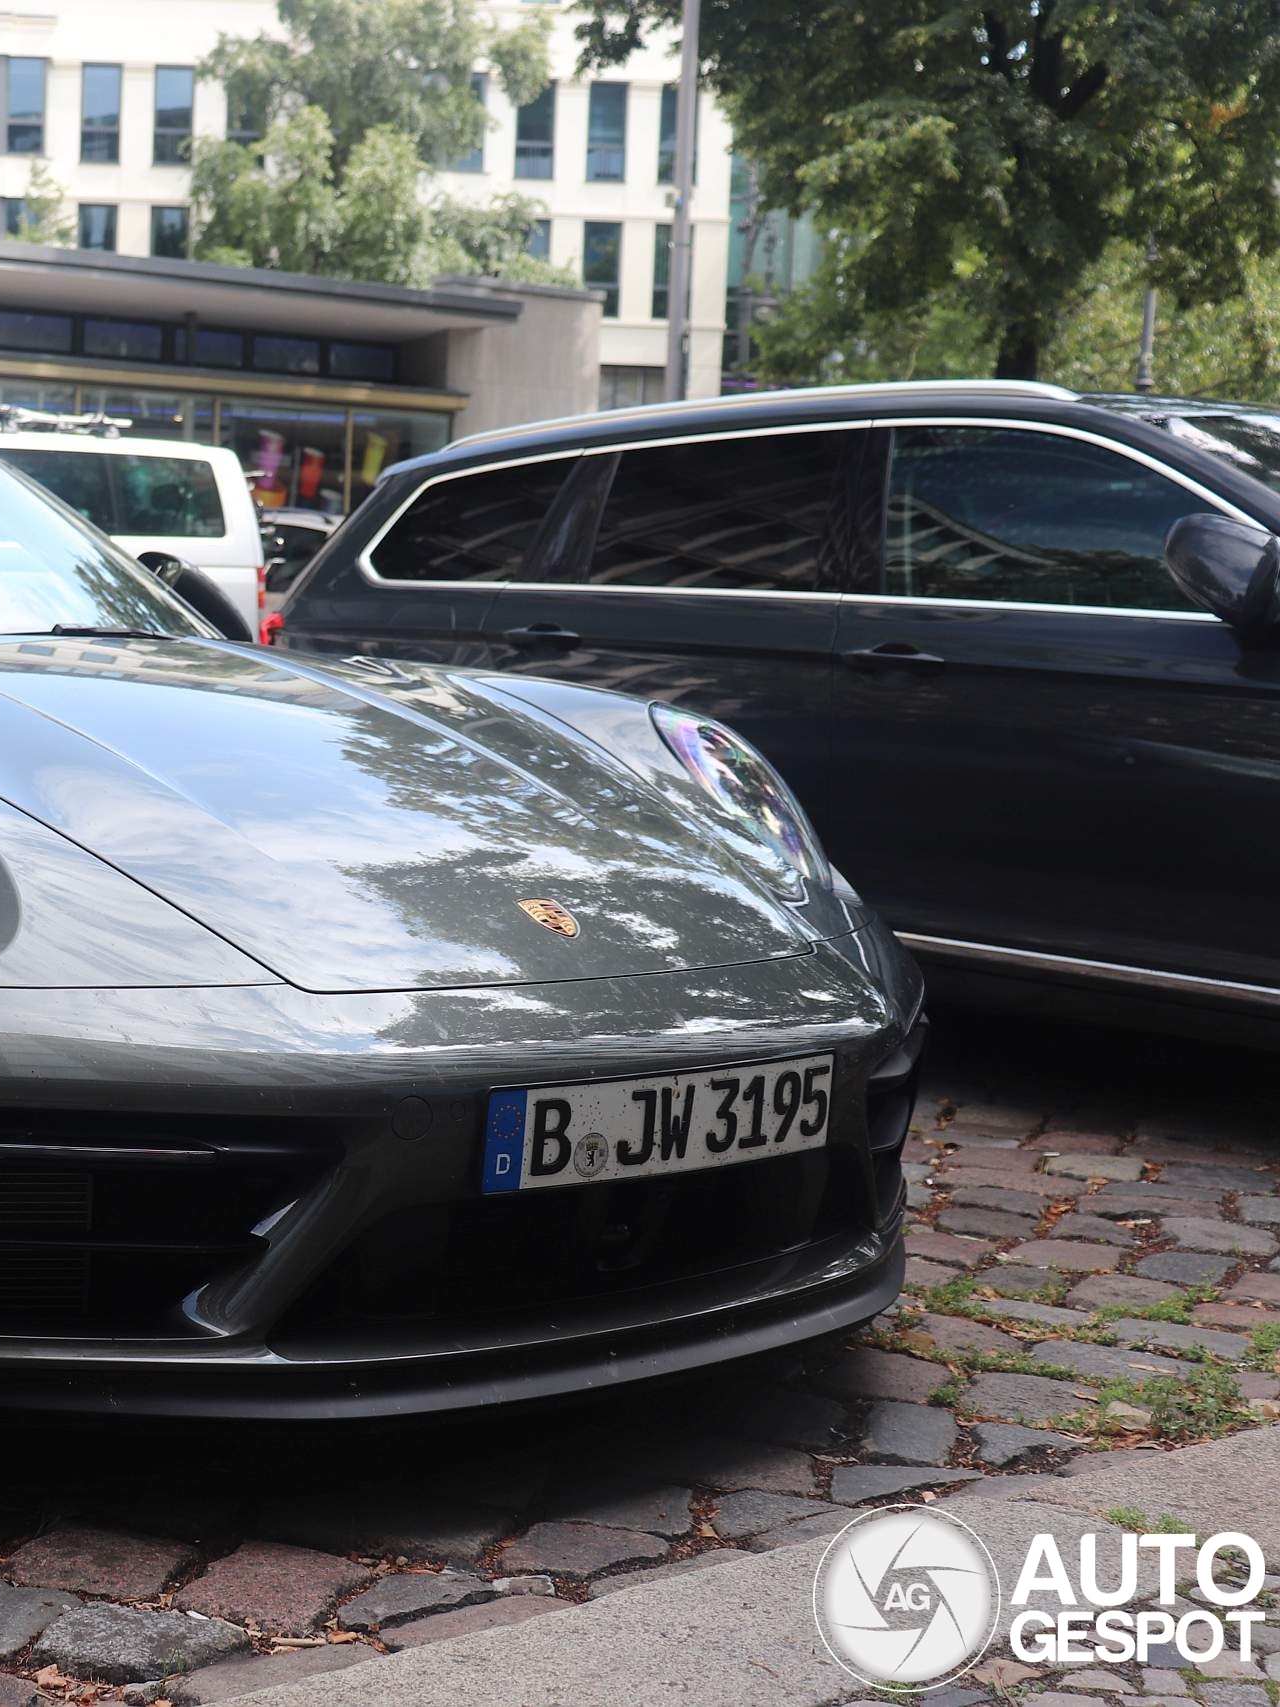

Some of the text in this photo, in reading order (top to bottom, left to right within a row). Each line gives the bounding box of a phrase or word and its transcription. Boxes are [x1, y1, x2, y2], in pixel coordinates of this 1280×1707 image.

[529, 1098, 572, 1176] B
[616, 1084, 695, 1166] JW
[705, 1065, 830, 1154] 3195
[494, 1153, 511, 1175] D
